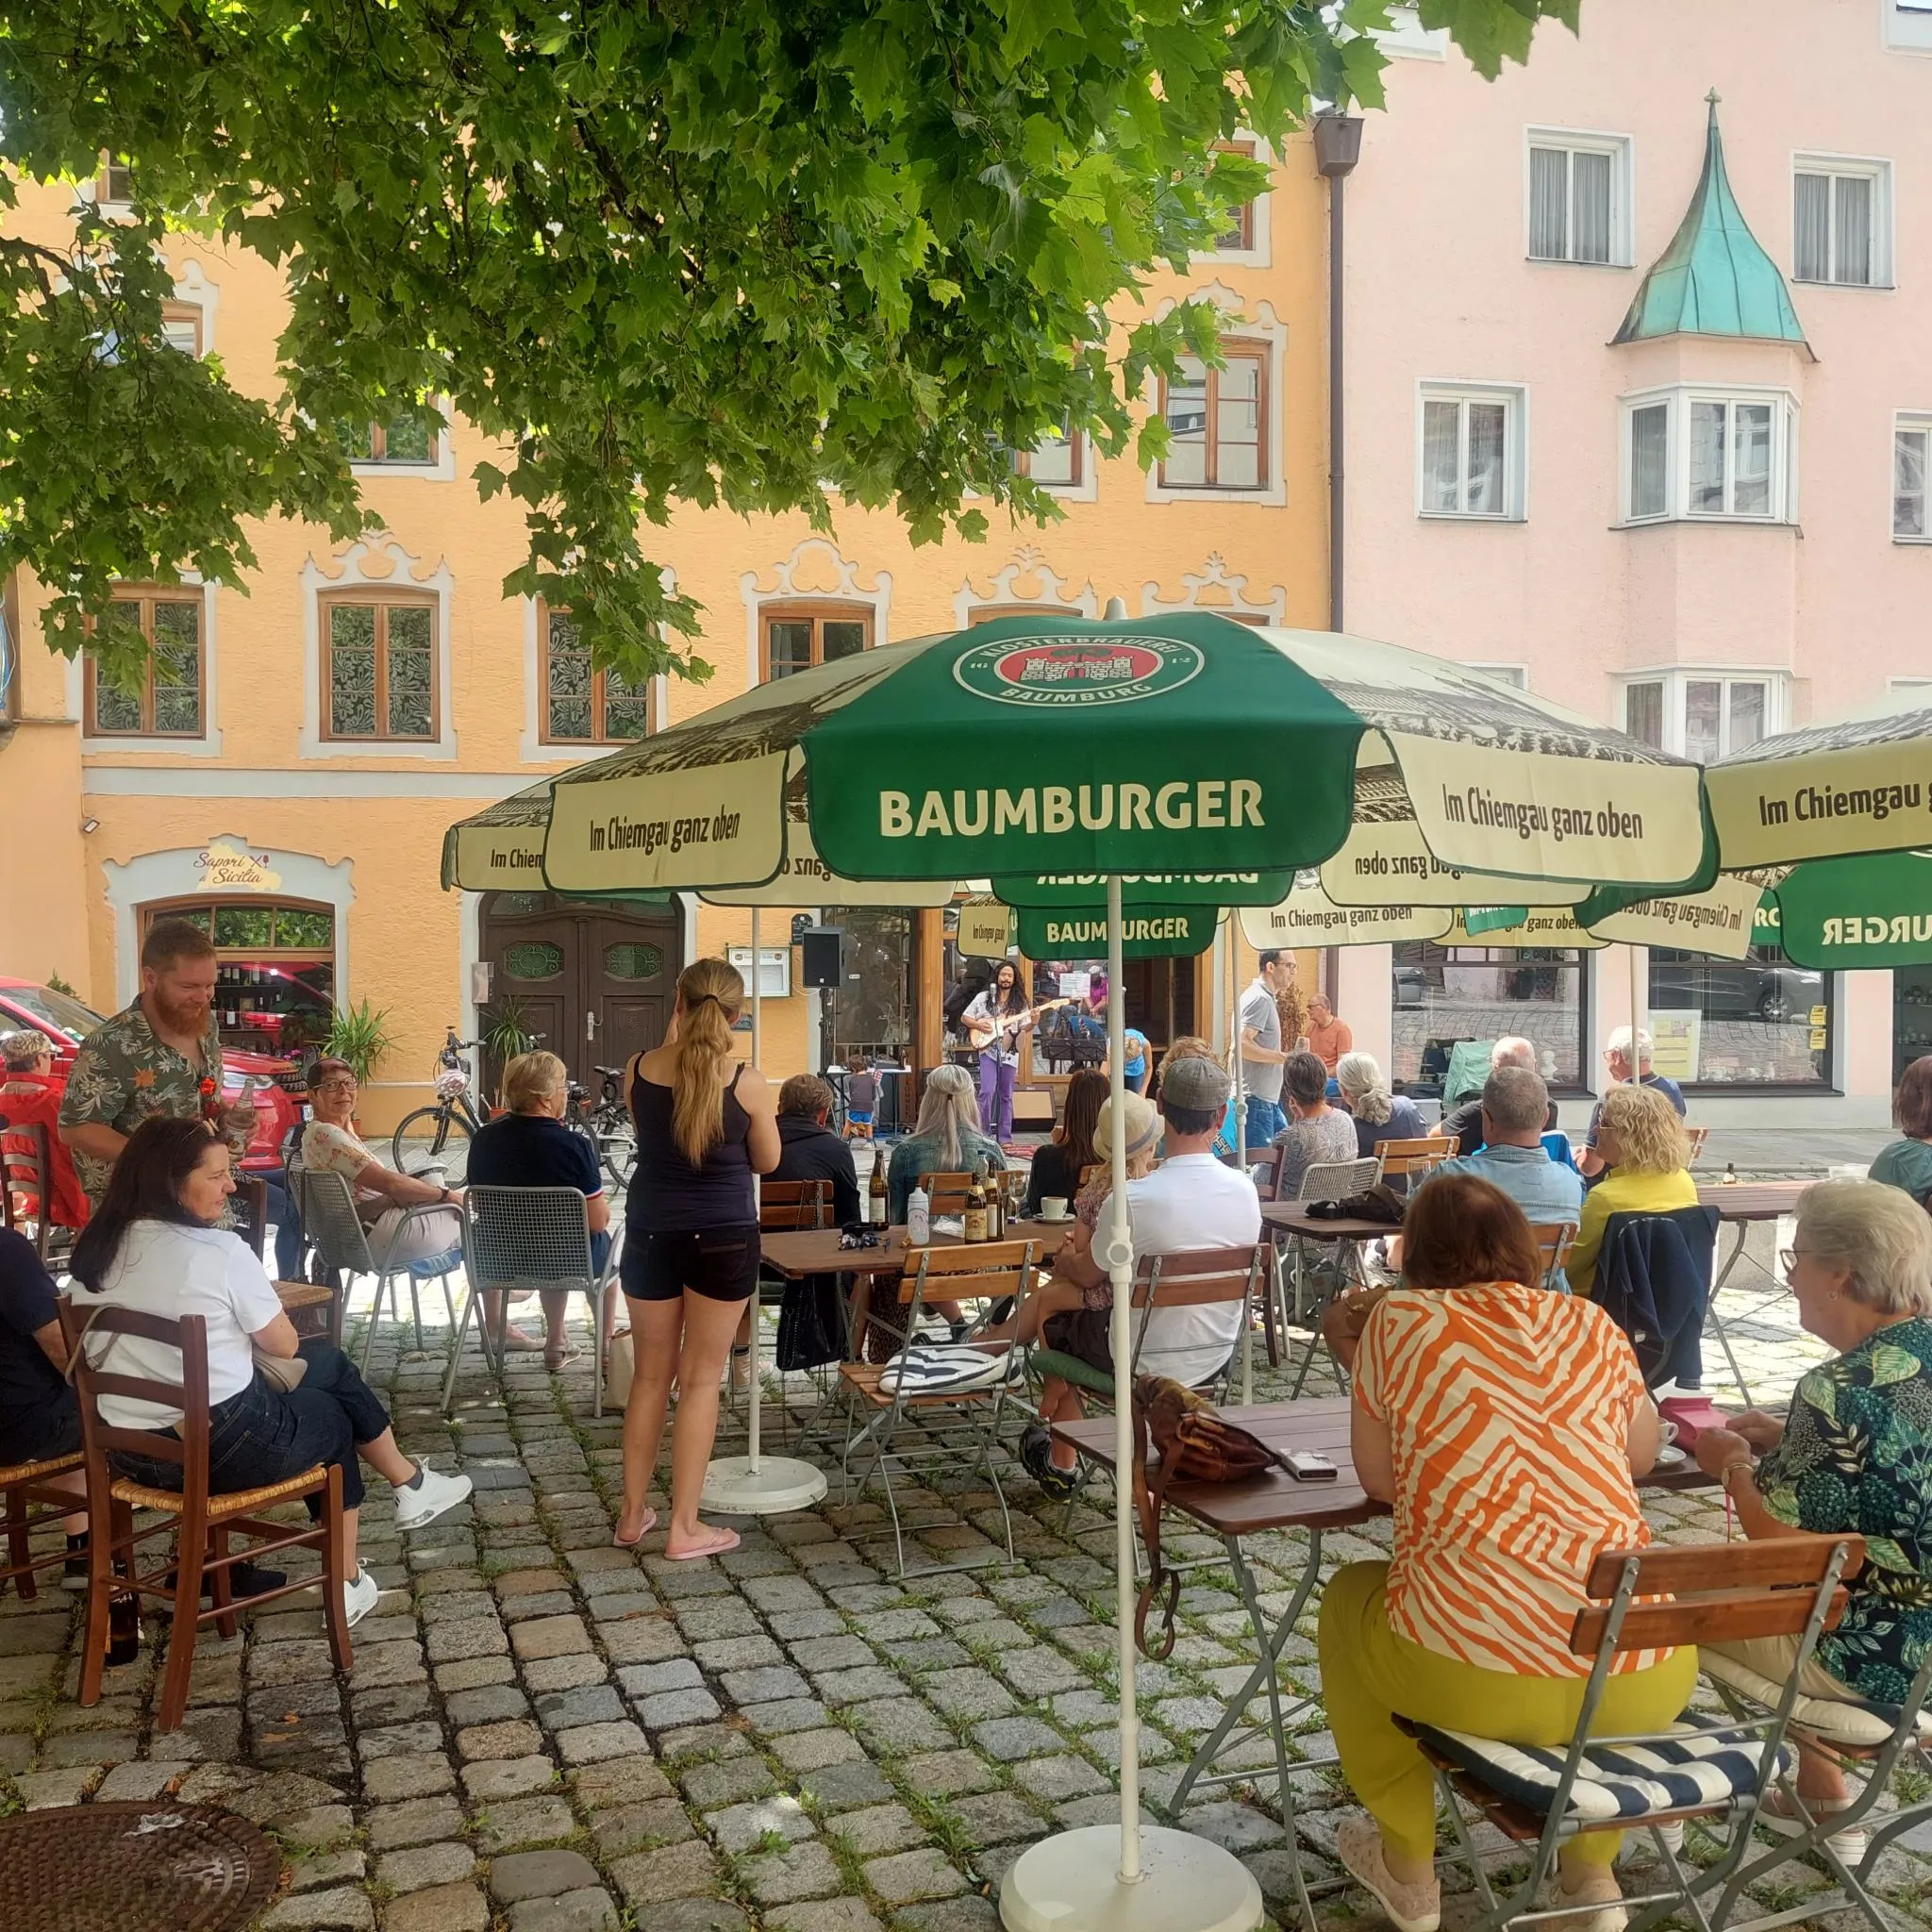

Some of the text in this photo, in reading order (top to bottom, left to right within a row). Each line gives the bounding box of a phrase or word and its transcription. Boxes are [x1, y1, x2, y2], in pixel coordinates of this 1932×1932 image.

[979, 637, 1183, 658] KLOSTERBRAUEREI
[1000, 684, 1153, 703] BAUMBURG
[879, 779, 1265, 838] BAUMBURGER
[1441, 783, 1643, 841] Im Chiemgau ganz oben
[1758, 795, 1789, 826] Im
[1794, 783, 1921, 821] Chiemgau
[590, 804, 741, 856] Im Chiemgau ganz oben
[193, 852, 245, 870] Sapori
[490, 848, 543, 869] Im Chiem
[212, 867, 262, 884] Sicilia
[1271, 911, 1286, 928] Im
[1289, 909, 1347, 929] Chiemgau
[1350, 908, 1379, 927] ganz
[1526, 917, 1554, 933] ganz
[1047, 918, 1189, 943] BAUMURGER
